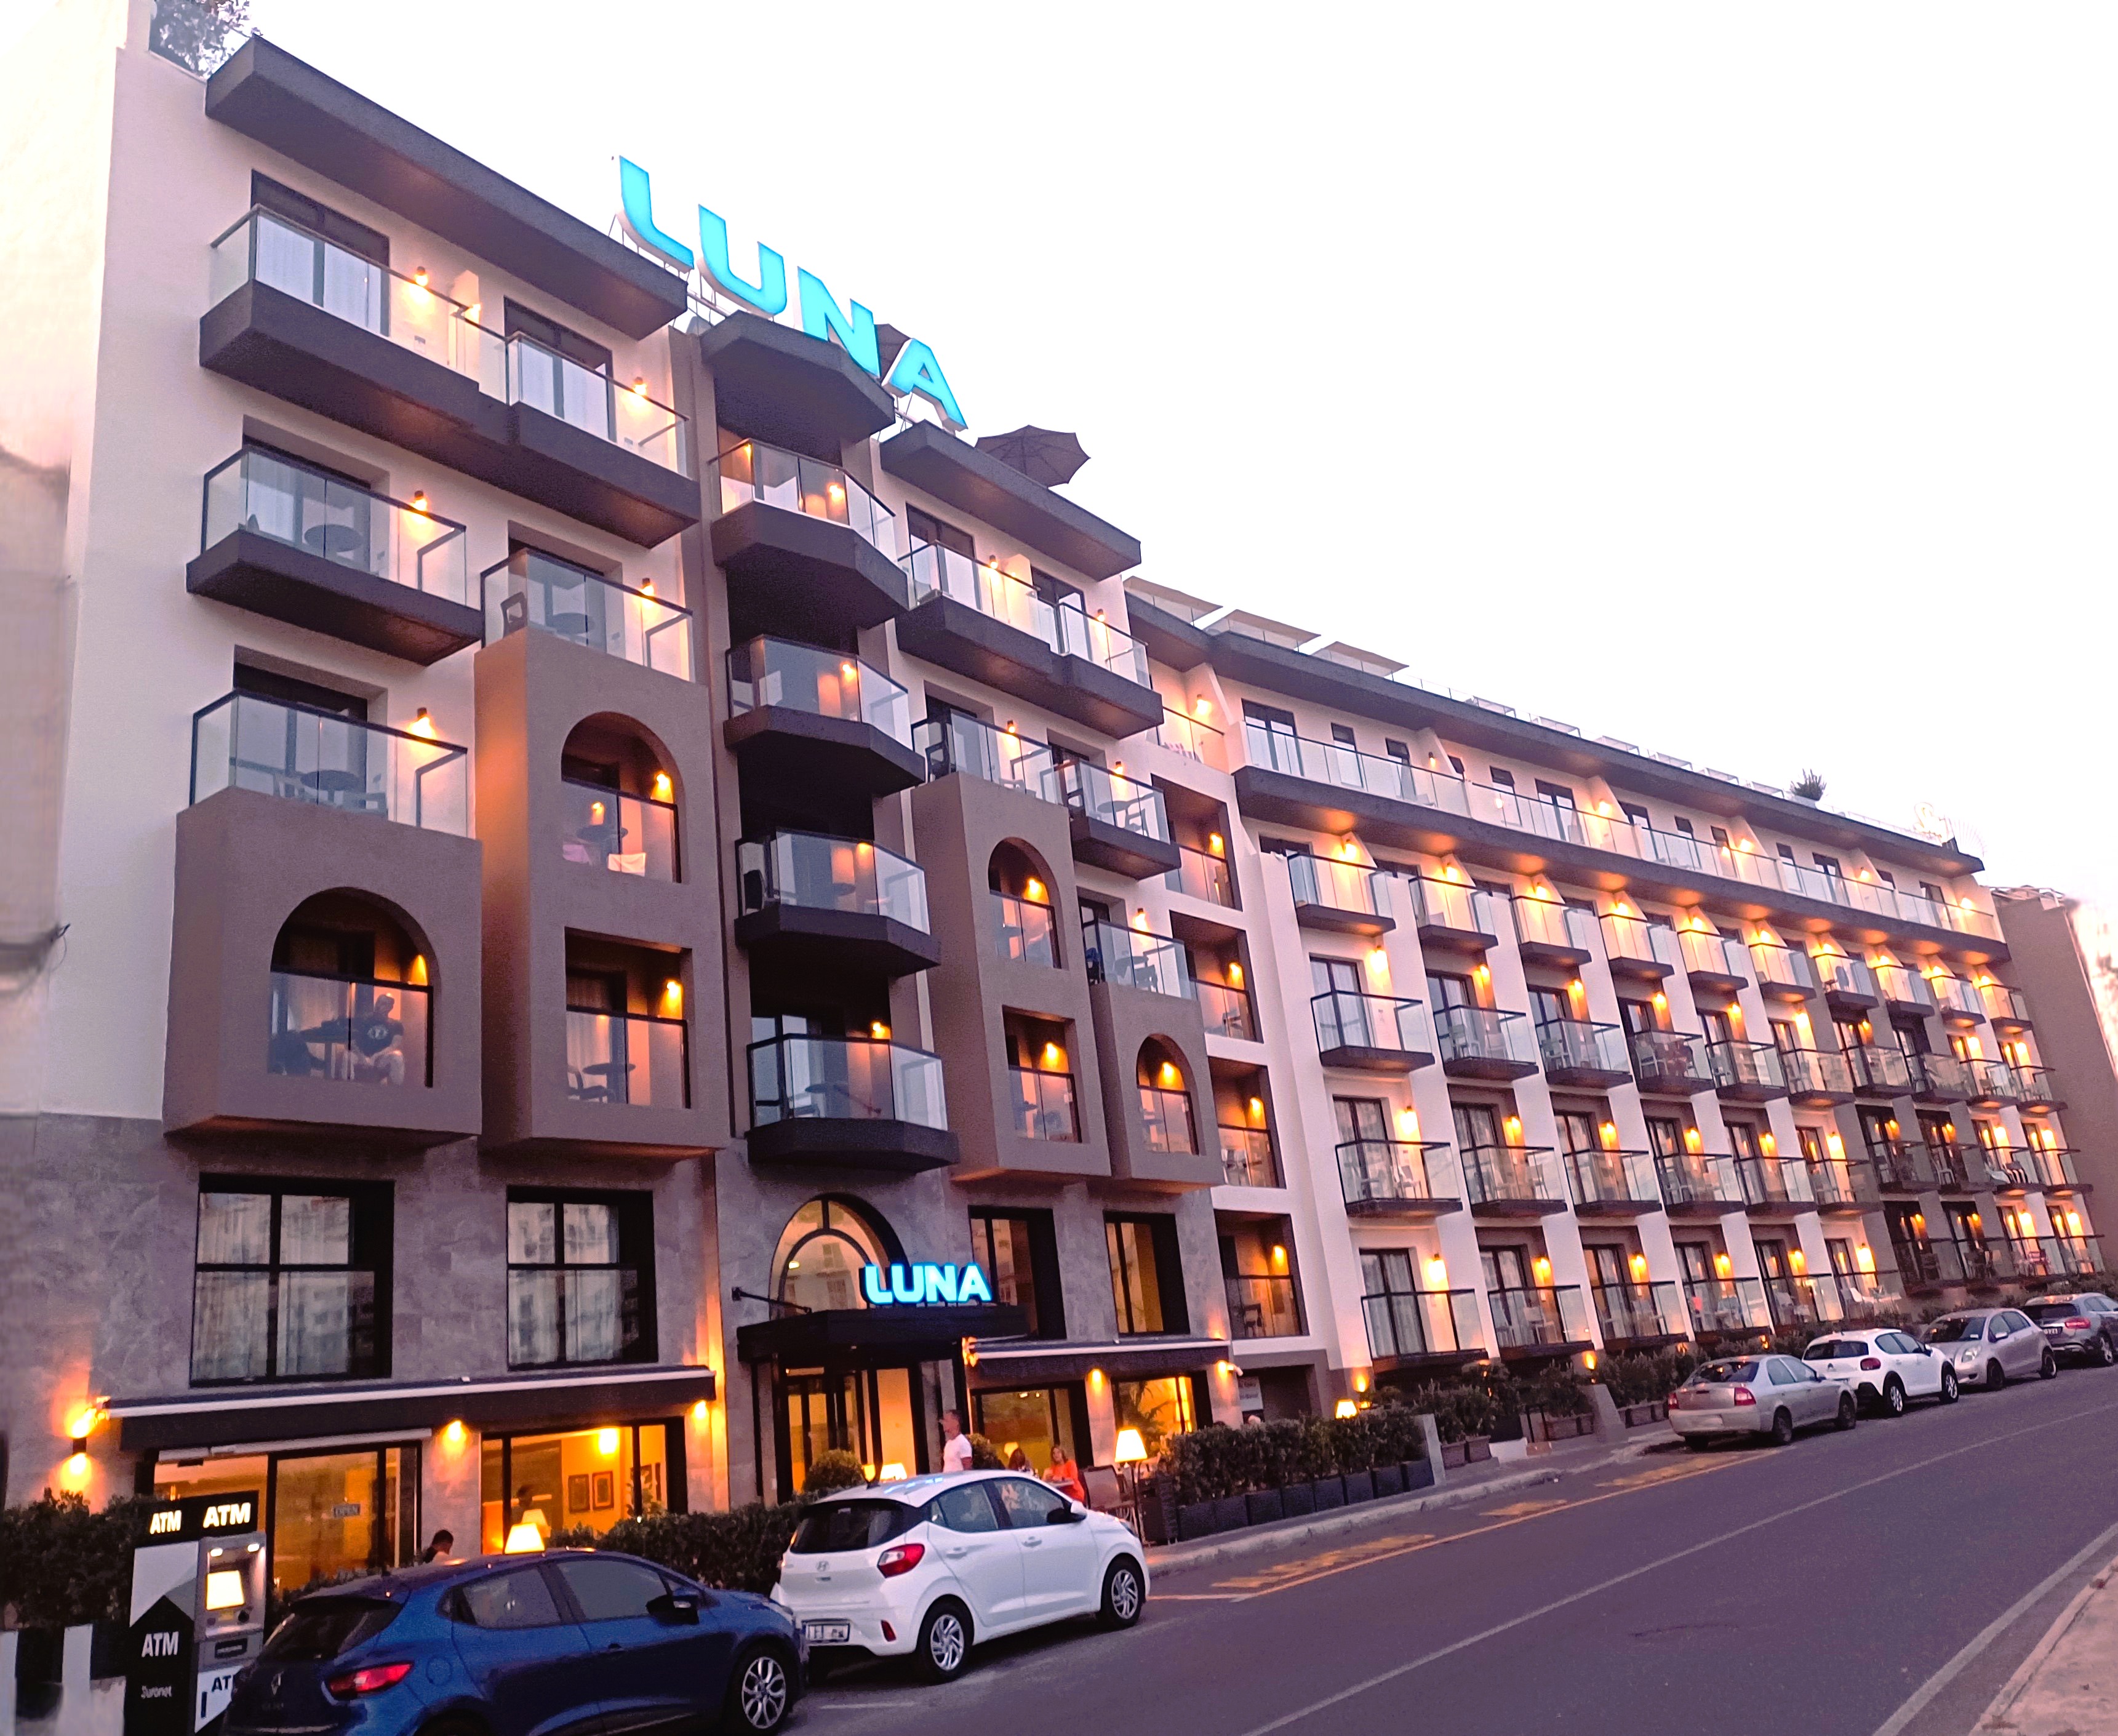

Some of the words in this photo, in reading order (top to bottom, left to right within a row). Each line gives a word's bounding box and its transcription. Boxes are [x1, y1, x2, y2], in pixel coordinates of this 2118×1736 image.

[619, 155, 969, 431] LUNA
[864, 1262, 992, 1305] LUNA
[150, 1510, 182, 1535] ATM
[202, 1502, 251, 1529] ATM
[141, 1631, 179, 1658] ATM
[211, 1674, 231, 1693] AT
